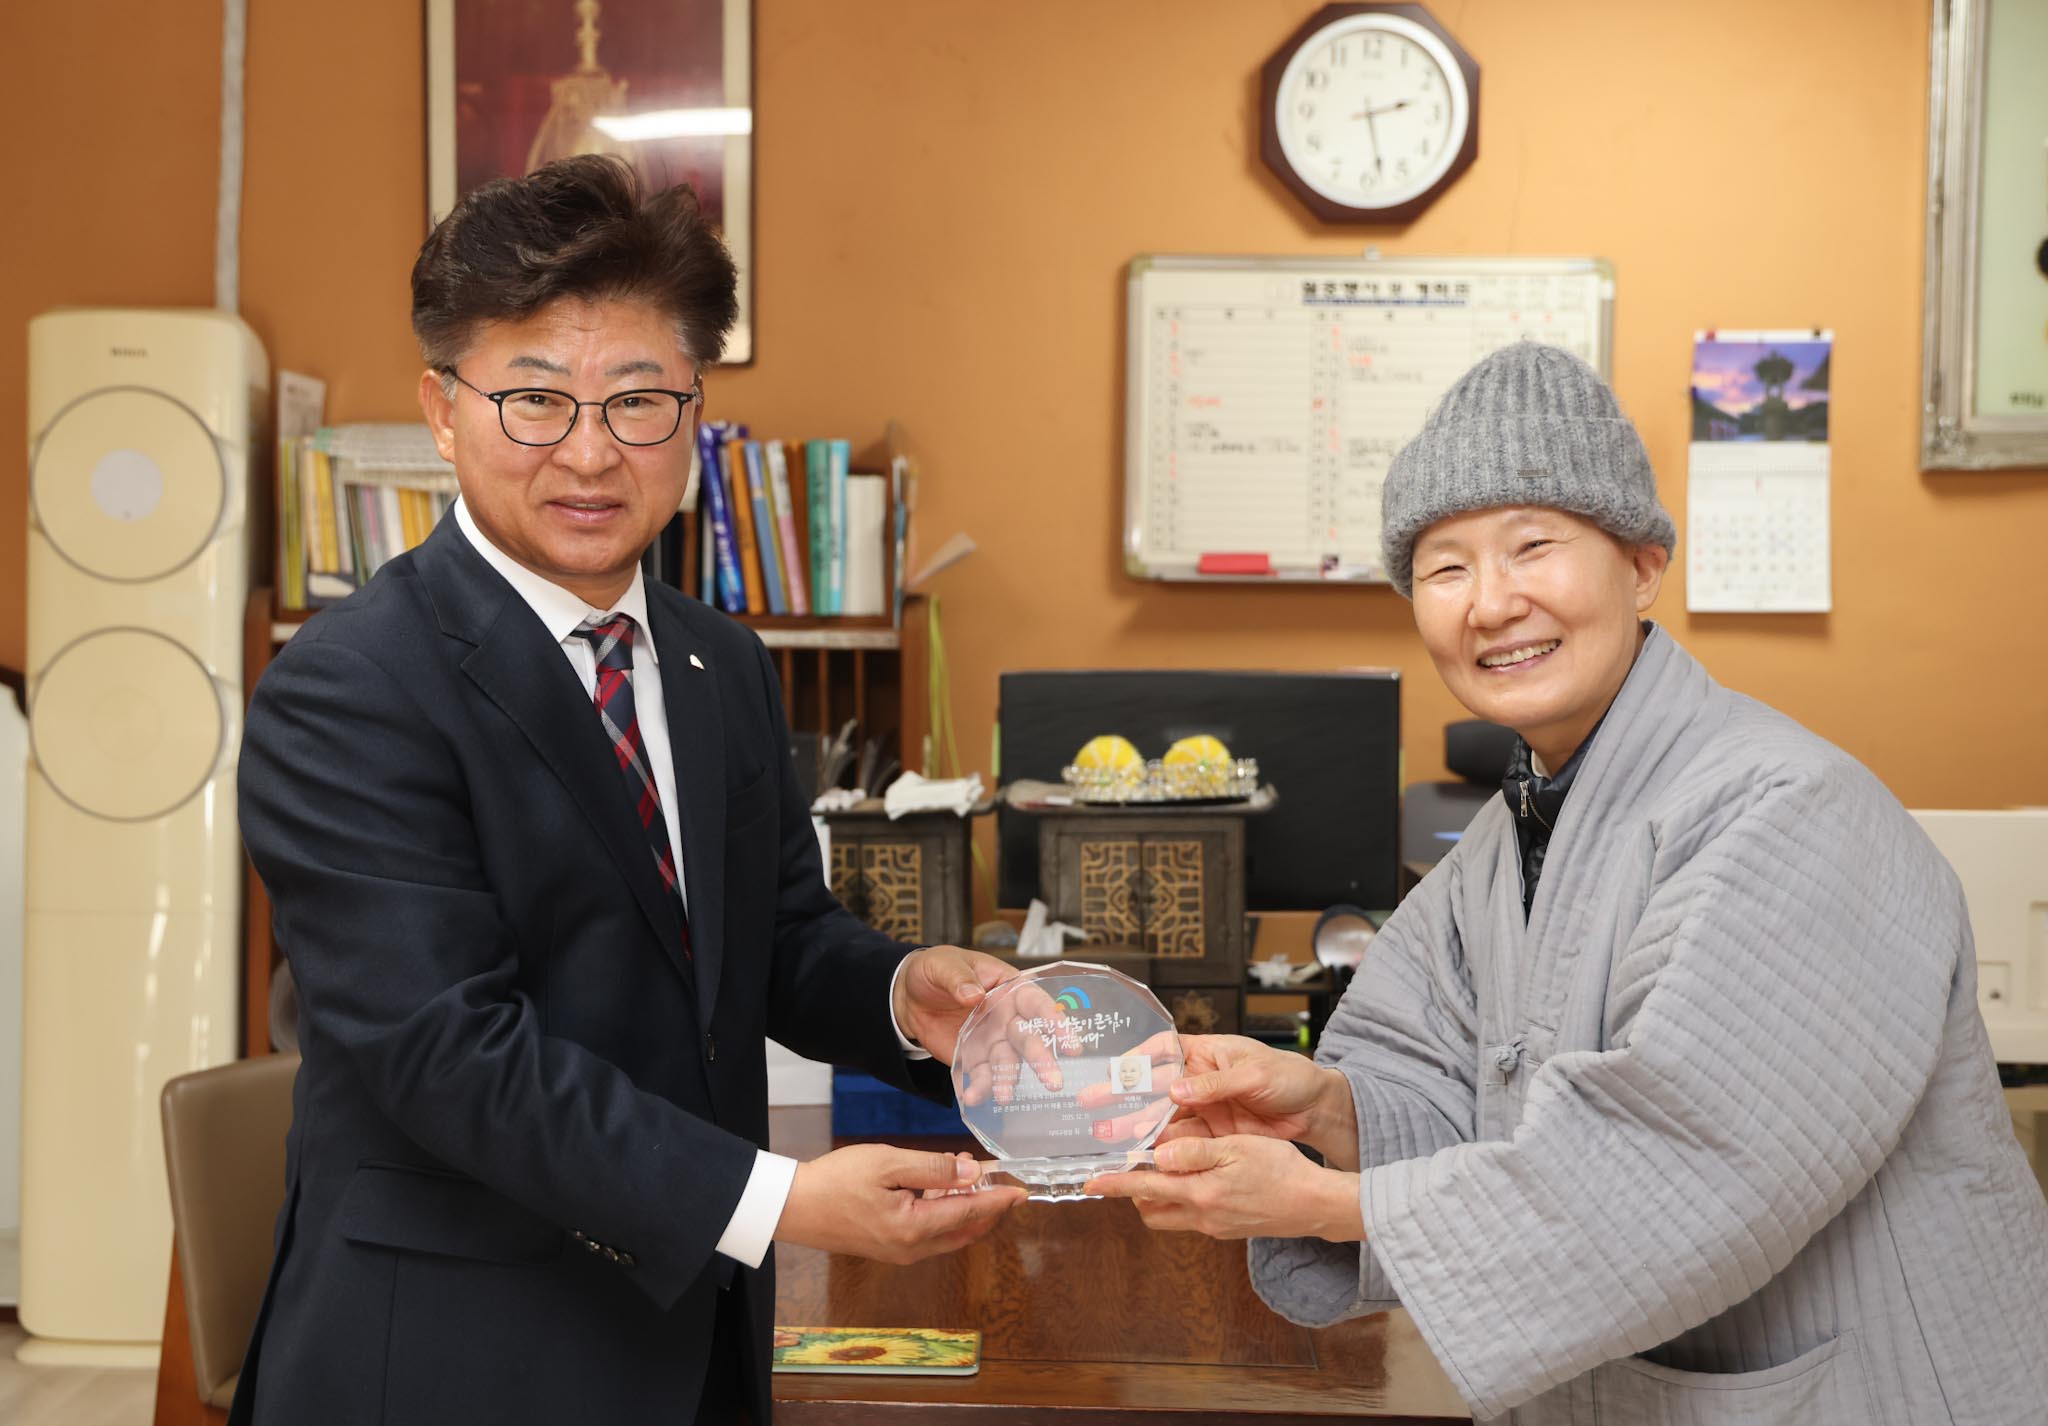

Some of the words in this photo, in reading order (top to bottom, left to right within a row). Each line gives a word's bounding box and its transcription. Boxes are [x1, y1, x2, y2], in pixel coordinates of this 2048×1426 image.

[1330, 43, 1347, 67] 11
[1363, 34, 1383, 59] 12
[1305, 71, 1328, 89] 10
[1016, 1017, 1055, 1036] 따뜻한
[1057, 1016, 1092, 1034] 나눔이
[1094, 1013, 1106, 1030] 큰
[1105, 1011, 1131, 1034] 힘이
[1041, 1031, 1104, 1059] 되었습니다
